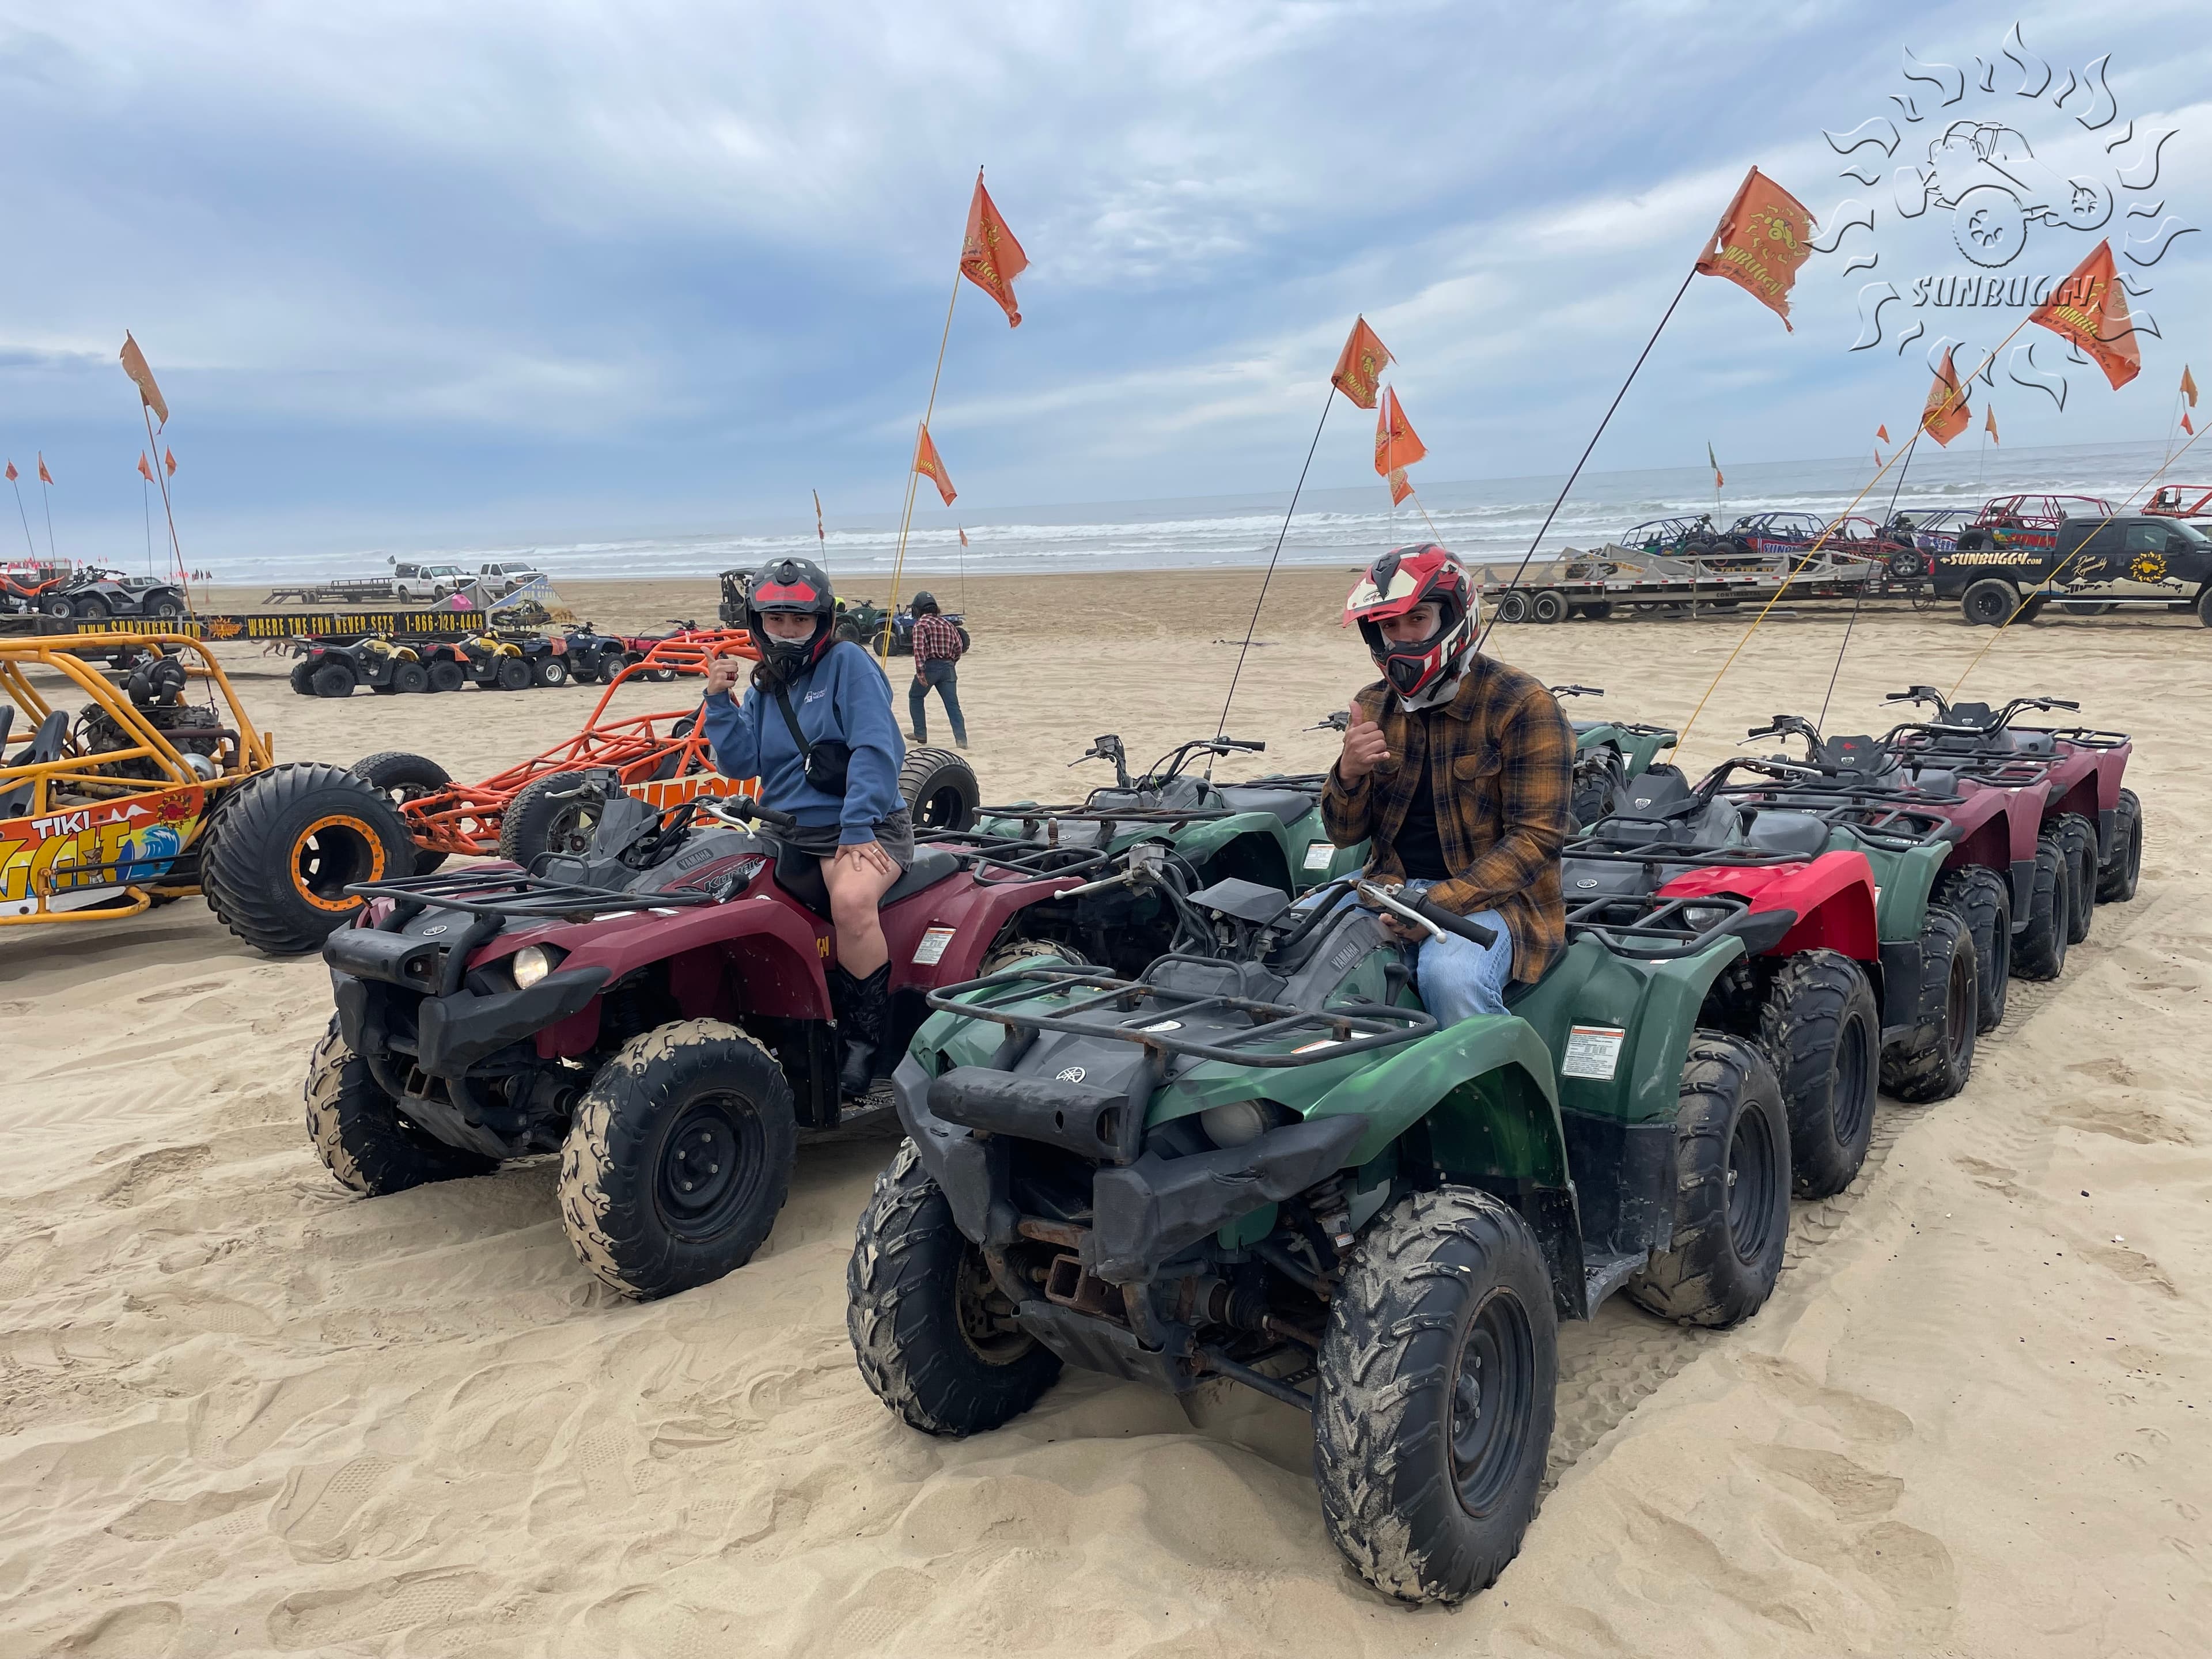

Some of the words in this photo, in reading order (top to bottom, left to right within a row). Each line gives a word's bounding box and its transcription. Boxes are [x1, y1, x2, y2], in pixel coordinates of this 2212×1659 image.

[1949, 552, 2043, 566] SUNBUGGY.COM
[248, 618, 285, 636] WHERE
[289, 618, 308, 635] THE
[312, 617, 331, 634] FUN
[335, 615, 366, 634] NEVER
[371, 615, 395, 633] SETS
[405, 613, 483, 632] 1-866-728-4443
[31, 810, 90, 839] TIKI
[679, 849, 711, 869] YAMAHA
[1330, 942, 1360, 970] YAMAHA
